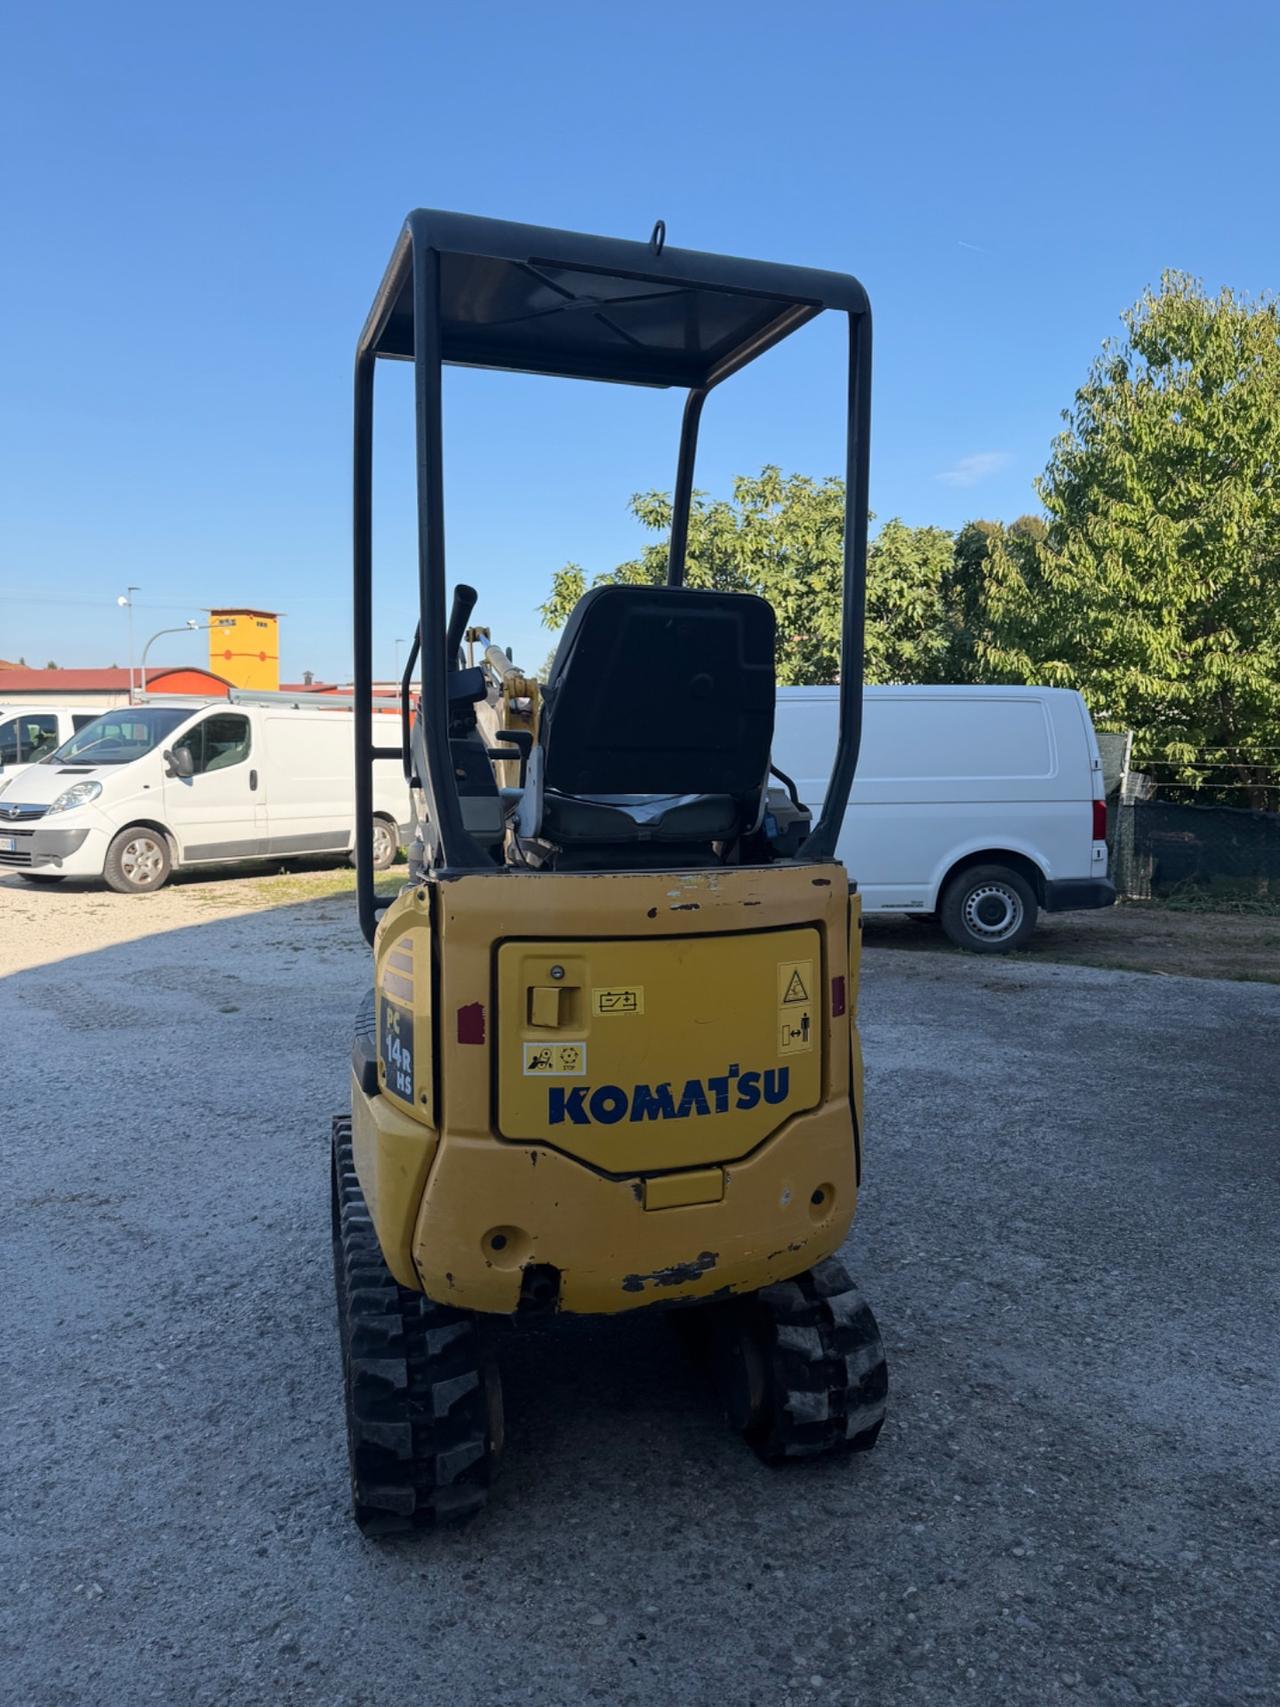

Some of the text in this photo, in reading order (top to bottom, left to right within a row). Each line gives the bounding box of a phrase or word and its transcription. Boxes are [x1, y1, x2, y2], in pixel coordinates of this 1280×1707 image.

[386, 1007, 400, 1034] PC
[386, 1034, 412, 1073] 14R
[396, 1071, 412, 1095] HS
[549, 1064, 790, 1125] KOMATSU
